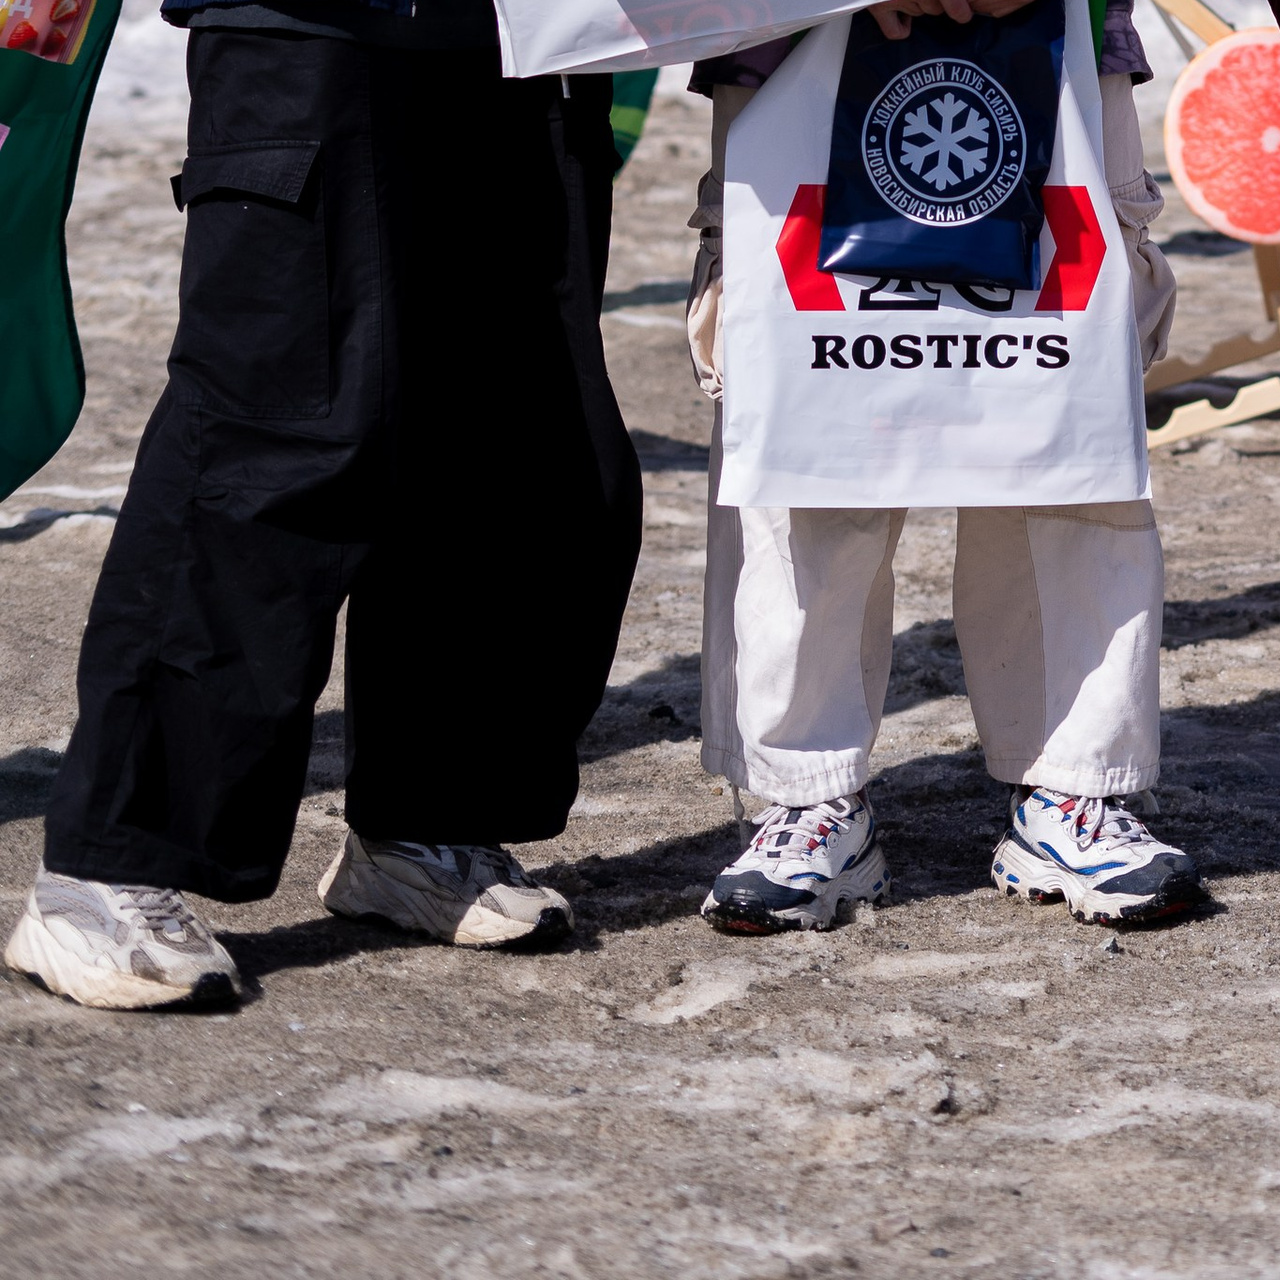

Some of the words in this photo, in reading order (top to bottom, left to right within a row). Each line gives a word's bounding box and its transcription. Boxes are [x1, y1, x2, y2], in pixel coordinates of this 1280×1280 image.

[872, 62, 945, 129] ХОККЕЙНЫЙ
[951, 65, 985, 92] КЛУБ
[984, 87, 1019, 142] СИБИРЬ
[867, 147, 966, 222] НОВОСИБИРСКАЯ
[968, 162, 1019, 215] ОБЛАСТЬ
[811, 334, 1070, 370] ROSTIC'S
